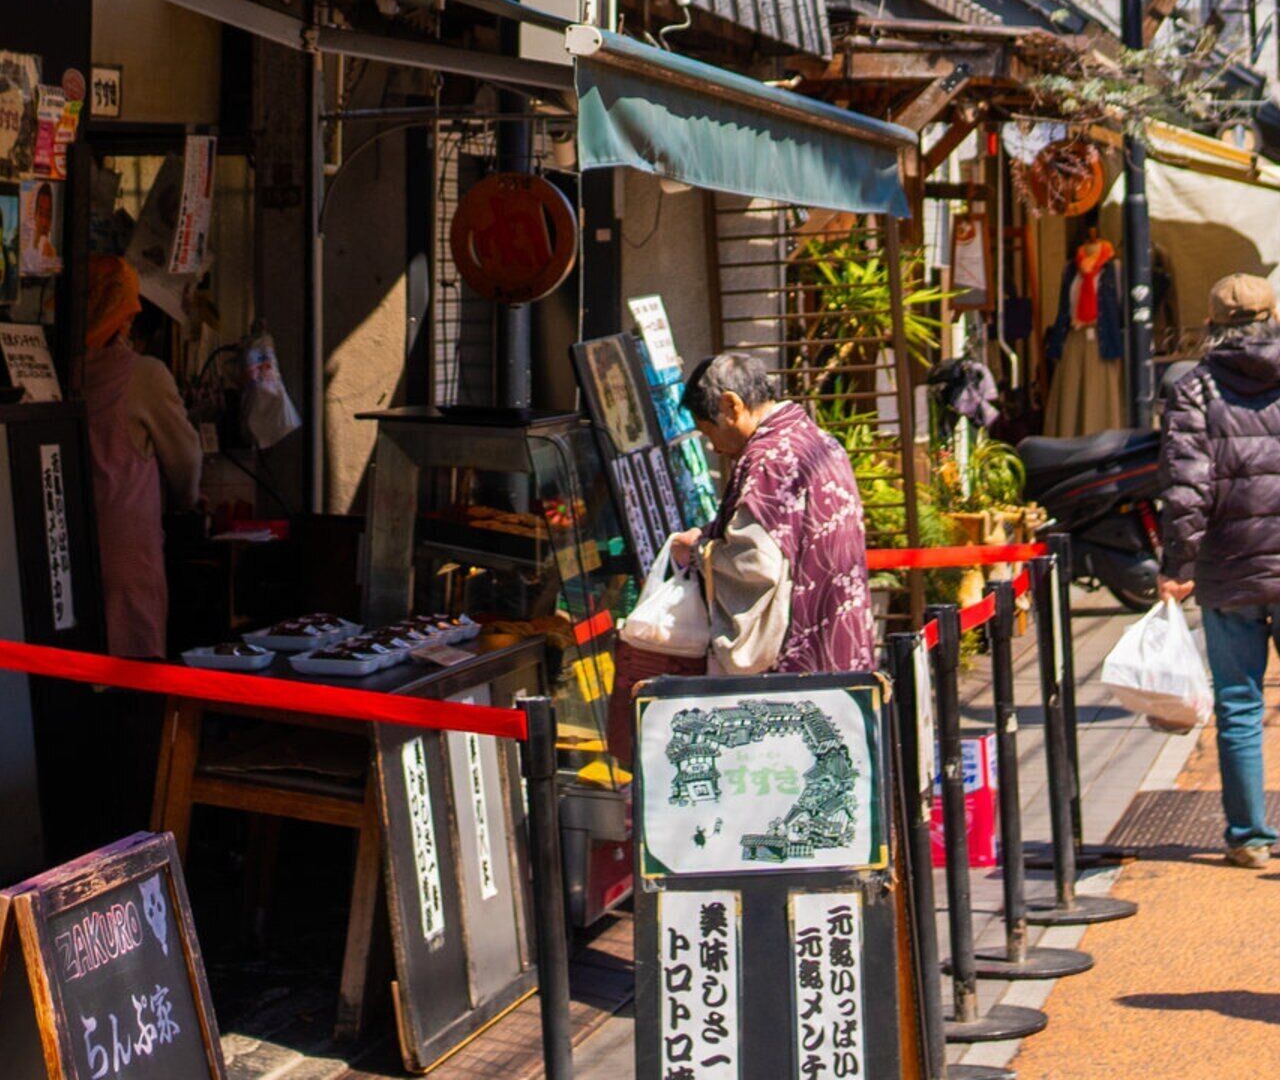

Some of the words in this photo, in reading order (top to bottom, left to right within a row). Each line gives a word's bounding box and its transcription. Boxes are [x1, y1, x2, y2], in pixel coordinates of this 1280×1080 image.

[55, 901, 144, 983] ZAKURO
[80, 984, 182, 1080] らんぷ家
